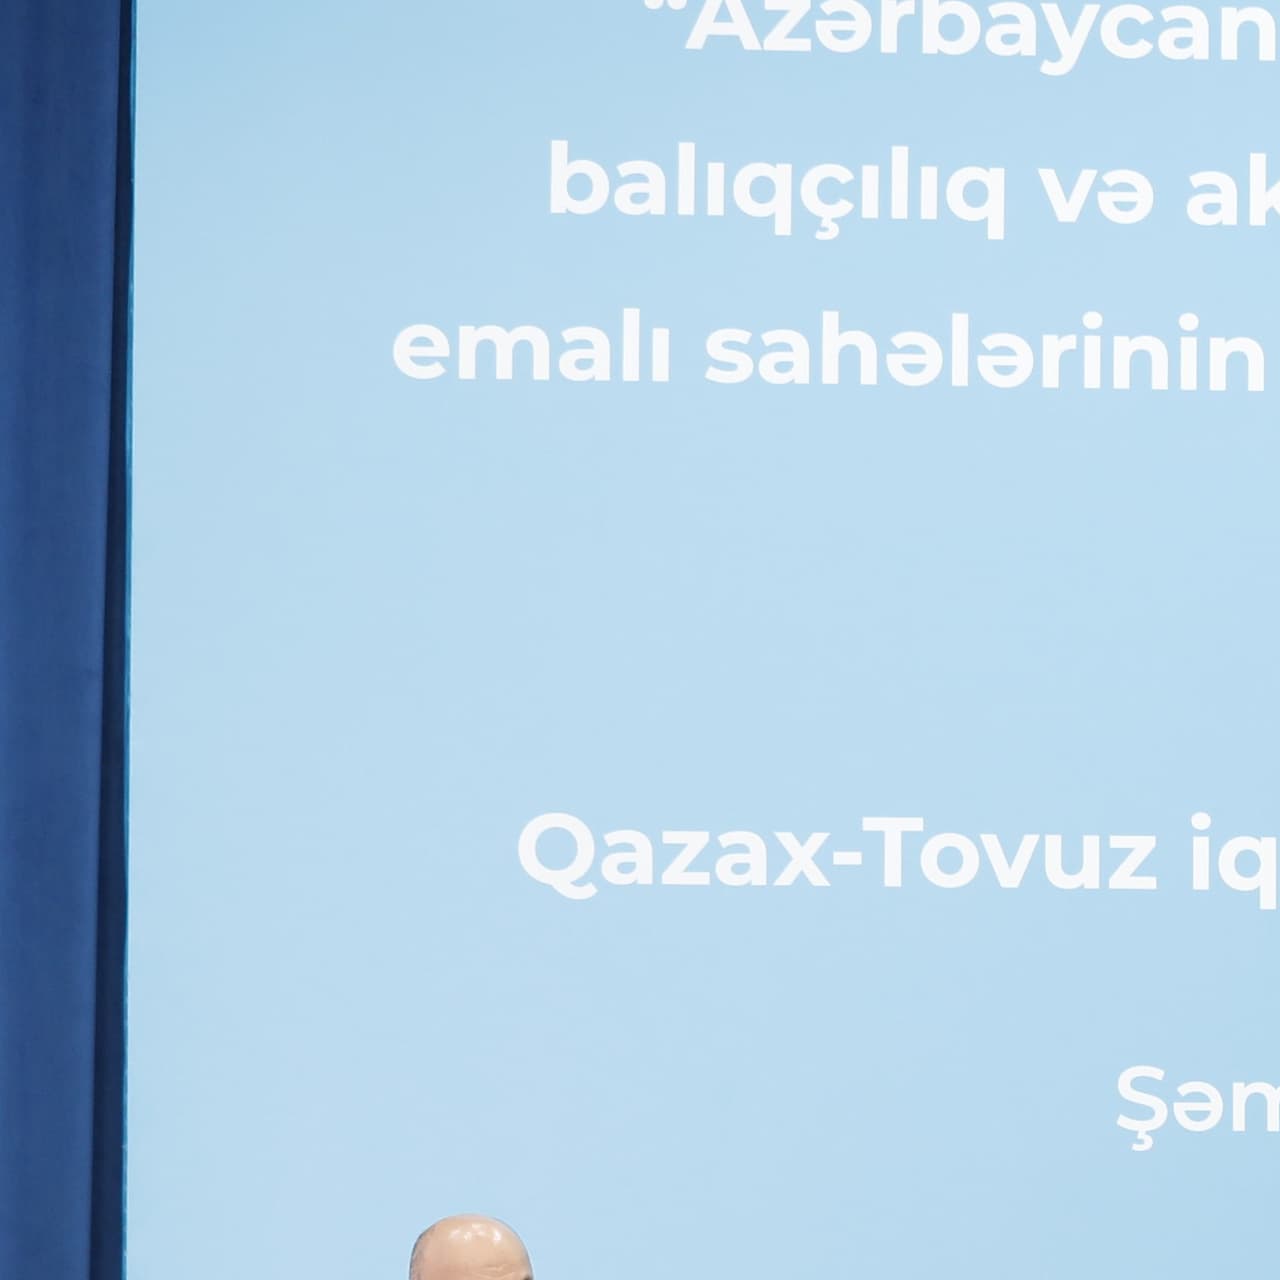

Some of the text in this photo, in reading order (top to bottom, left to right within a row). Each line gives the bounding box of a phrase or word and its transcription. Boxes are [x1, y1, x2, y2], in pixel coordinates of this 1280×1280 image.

[550, 140, 1005, 240] balıqçılıq
[1039, 168, 1153, 224] və
[393, 308, 669, 382] emalı
[705, 311, 1264, 391] sahələrinin
[518, 813, 1157, 899] Qazax-Tovuz
